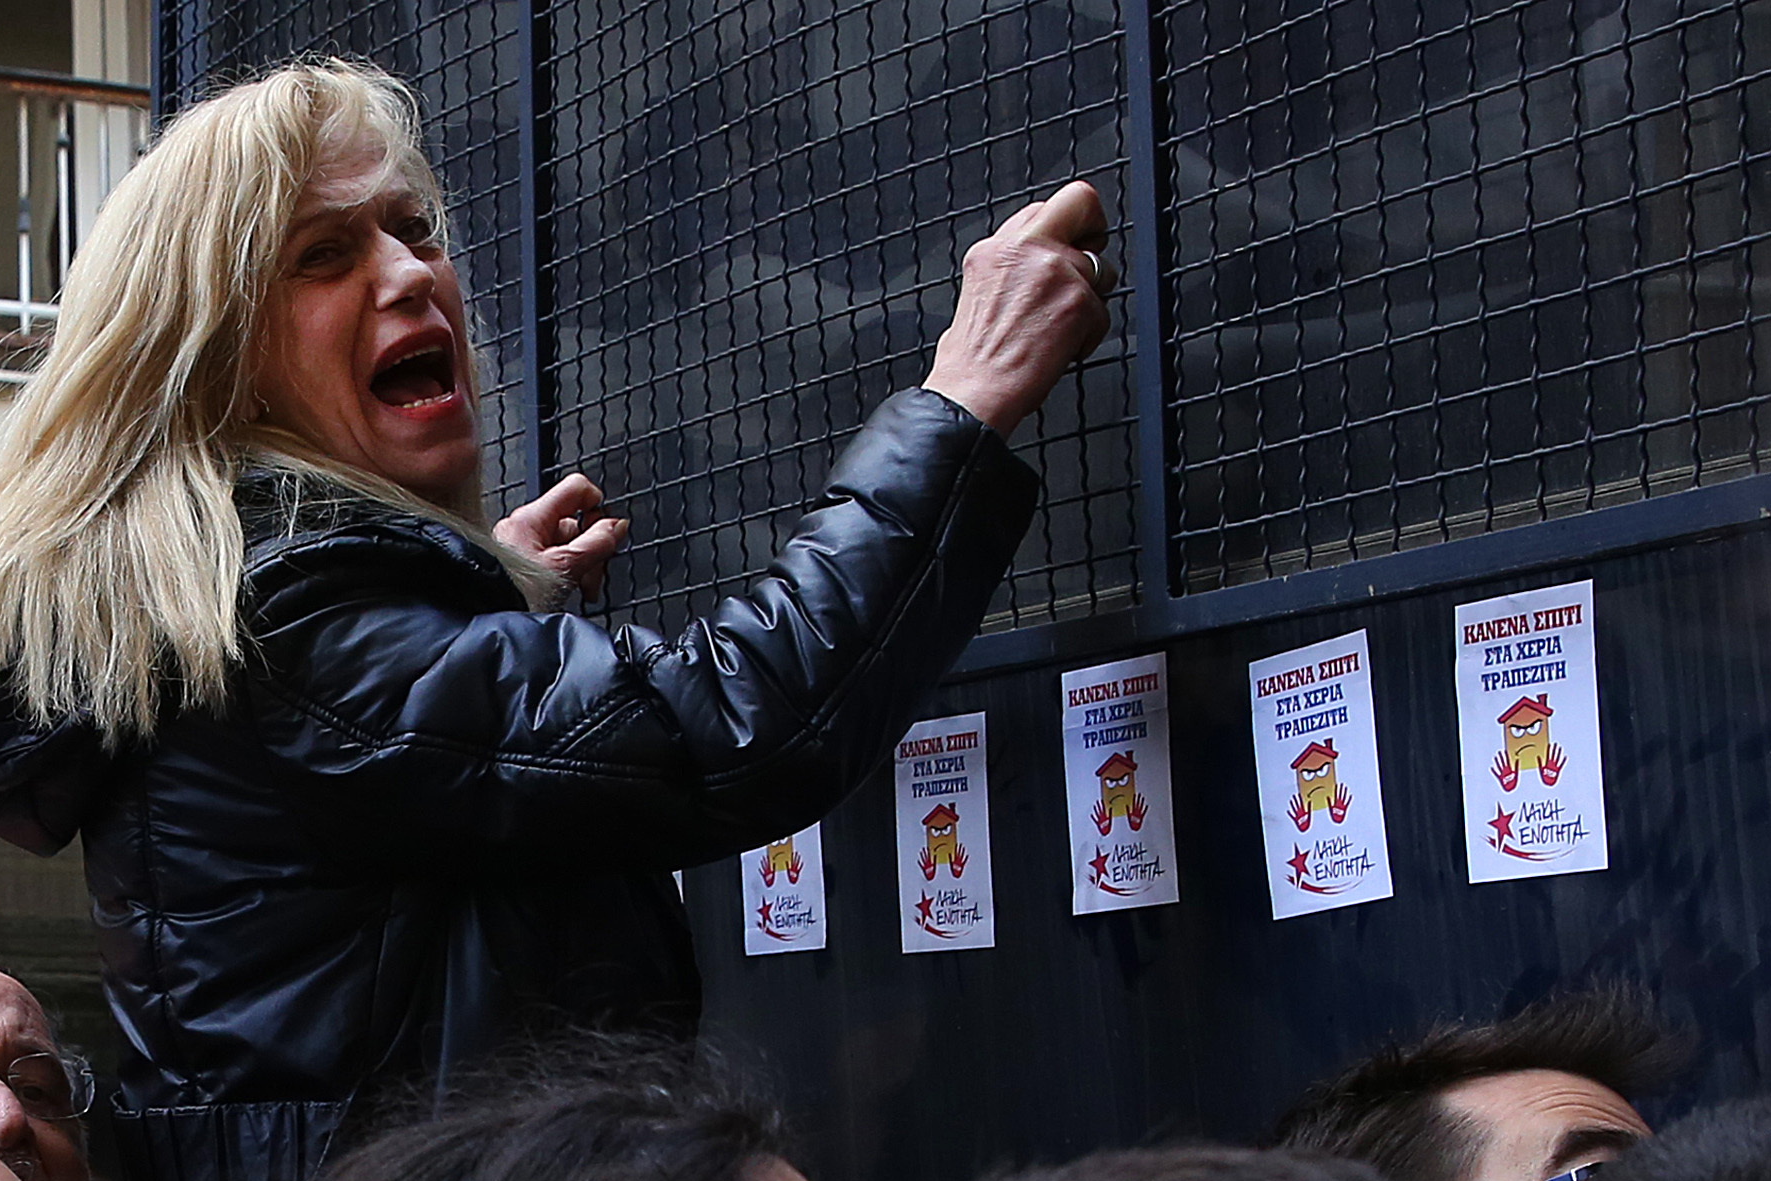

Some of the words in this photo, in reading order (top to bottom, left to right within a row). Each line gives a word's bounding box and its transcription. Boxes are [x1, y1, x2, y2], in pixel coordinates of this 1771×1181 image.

[1463, 614, 1530, 645] ΚΑΝΕΝΑ
[1533, 604, 1582, 631] ΣΠΙΤΙ
[1484, 643, 1513, 667] ΣΤΑ
[1516, 635, 1562, 661] ΧΕΡΙΑ
[1068, 681, 1119, 708] ΚΑΝΕΝΑ
[1123, 673, 1158, 697] ΣΠΙΤΙ
[1257, 665, 1315, 698] ΚΑΝΕΝΑ
[1318, 652, 1360, 681] ΣΠΙΤΙ
[1481, 661, 1566, 692] ΤΡΑΠΕΖΙΤΗ
[1084, 707, 1106, 726] ΣΤΑ
[1109, 700, 1143, 721] ΧΕΡΙΑ
[1276, 695, 1301, 717] ΣΤΑ
[1303, 683, 1344, 710] ΧΕΡΙΑ
[1083, 721, 1147, 749] ΤΡΑΠΕΖΙΤΗ
[1275, 706, 1348, 741] ΤΡΑΠΕΖΙΤΗ
[900, 736, 943, 758] ΚΑΝΕΝΑ
[946, 731, 978, 751] ΣΠΙΤΙ
[913, 761, 932, 777] ΣΤΑ
[934, 756, 965, 773] ΧΕΡΙΑ
[912, 776, 968, 798] ΤΡΑΠΕΖΙΤΗ
[1519, 814, 1590, 846] ΕΝΟΤΗΤΑ
[1314, 848, 1375, 881] ΕΝΟΤΗΤΑ
